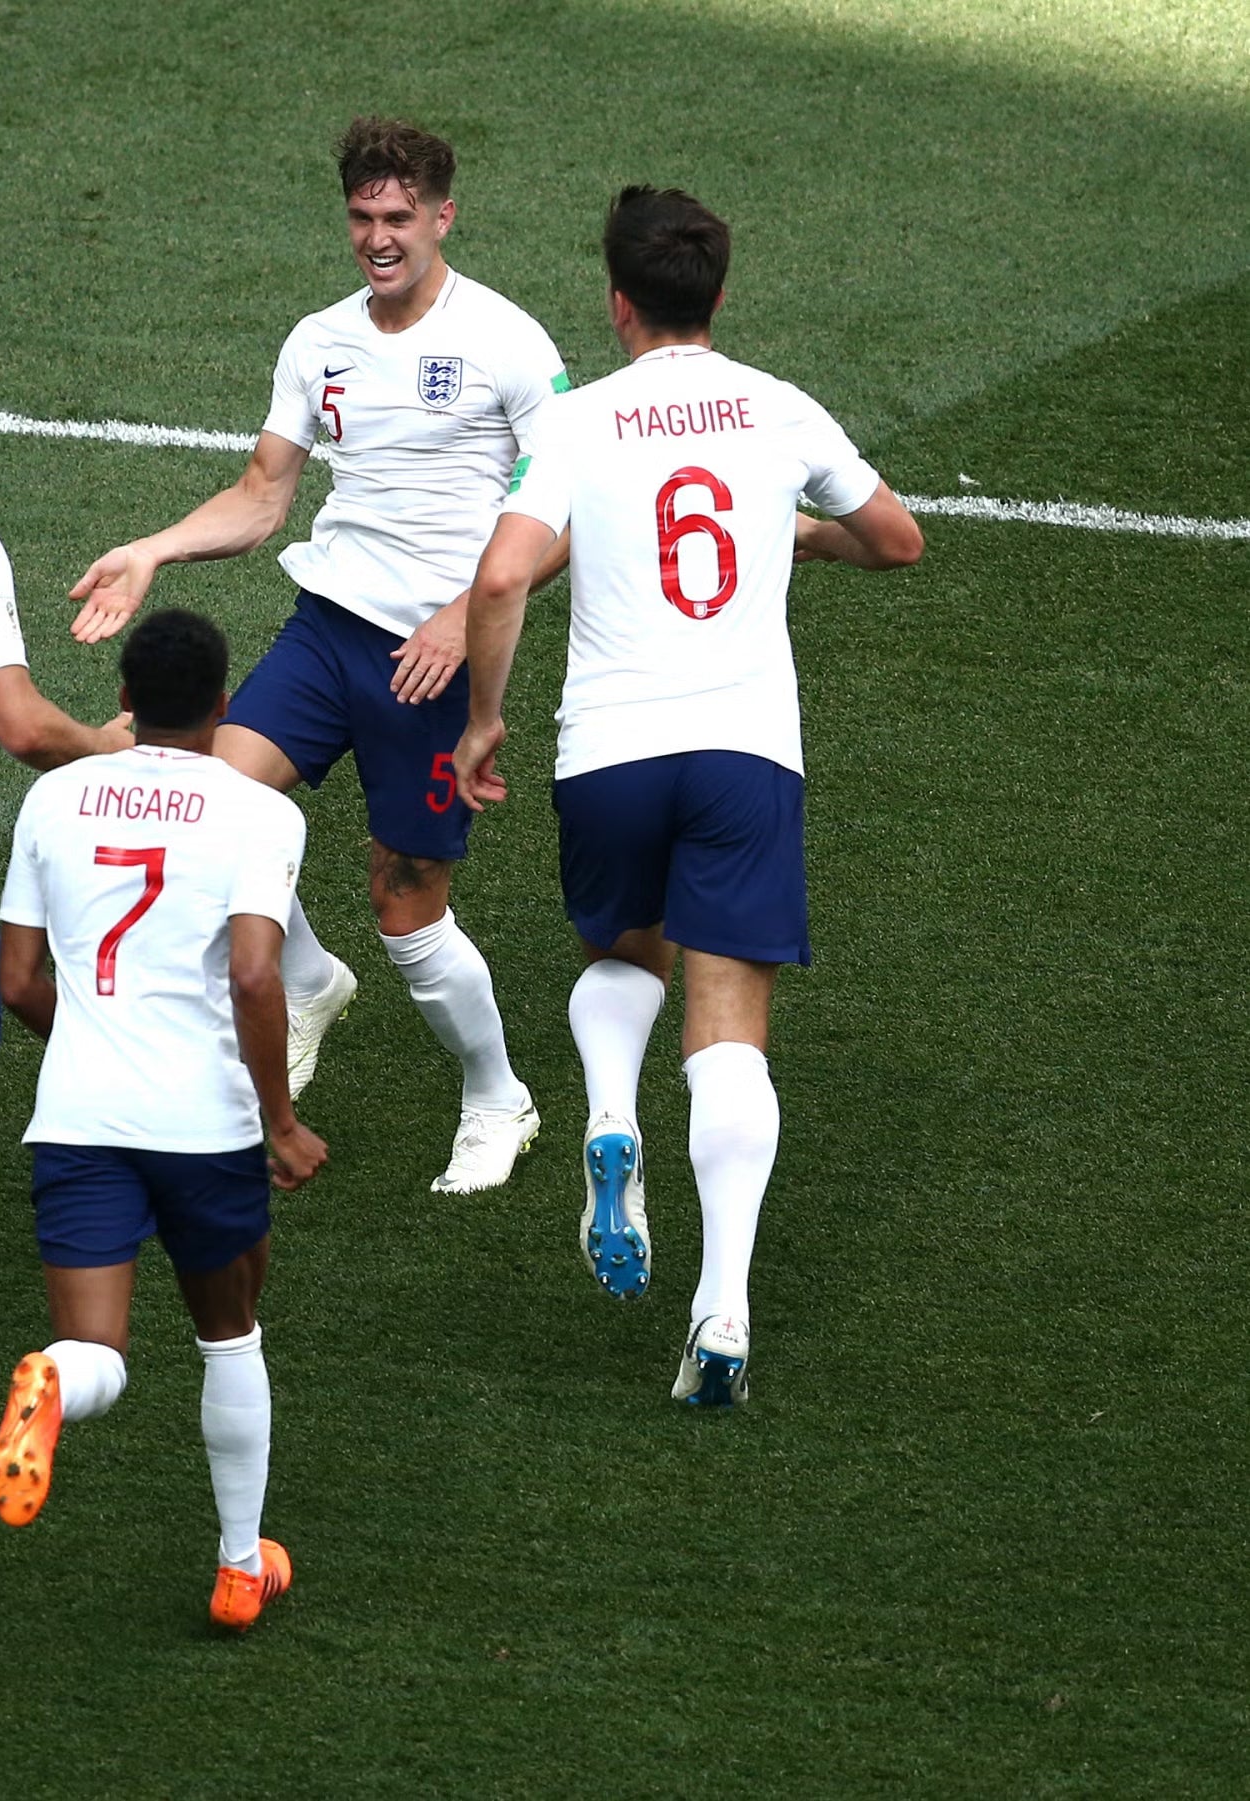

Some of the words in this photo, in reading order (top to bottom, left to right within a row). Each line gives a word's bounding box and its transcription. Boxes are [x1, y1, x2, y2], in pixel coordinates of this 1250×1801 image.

[614, 397, 755, 440] MAGUIRE
[655, 465, 738, 621] 6
[78, 784, 206, 824] LINGARD
[425, 752, 458, 814] 5
[93, 845, 167, 997] 7
